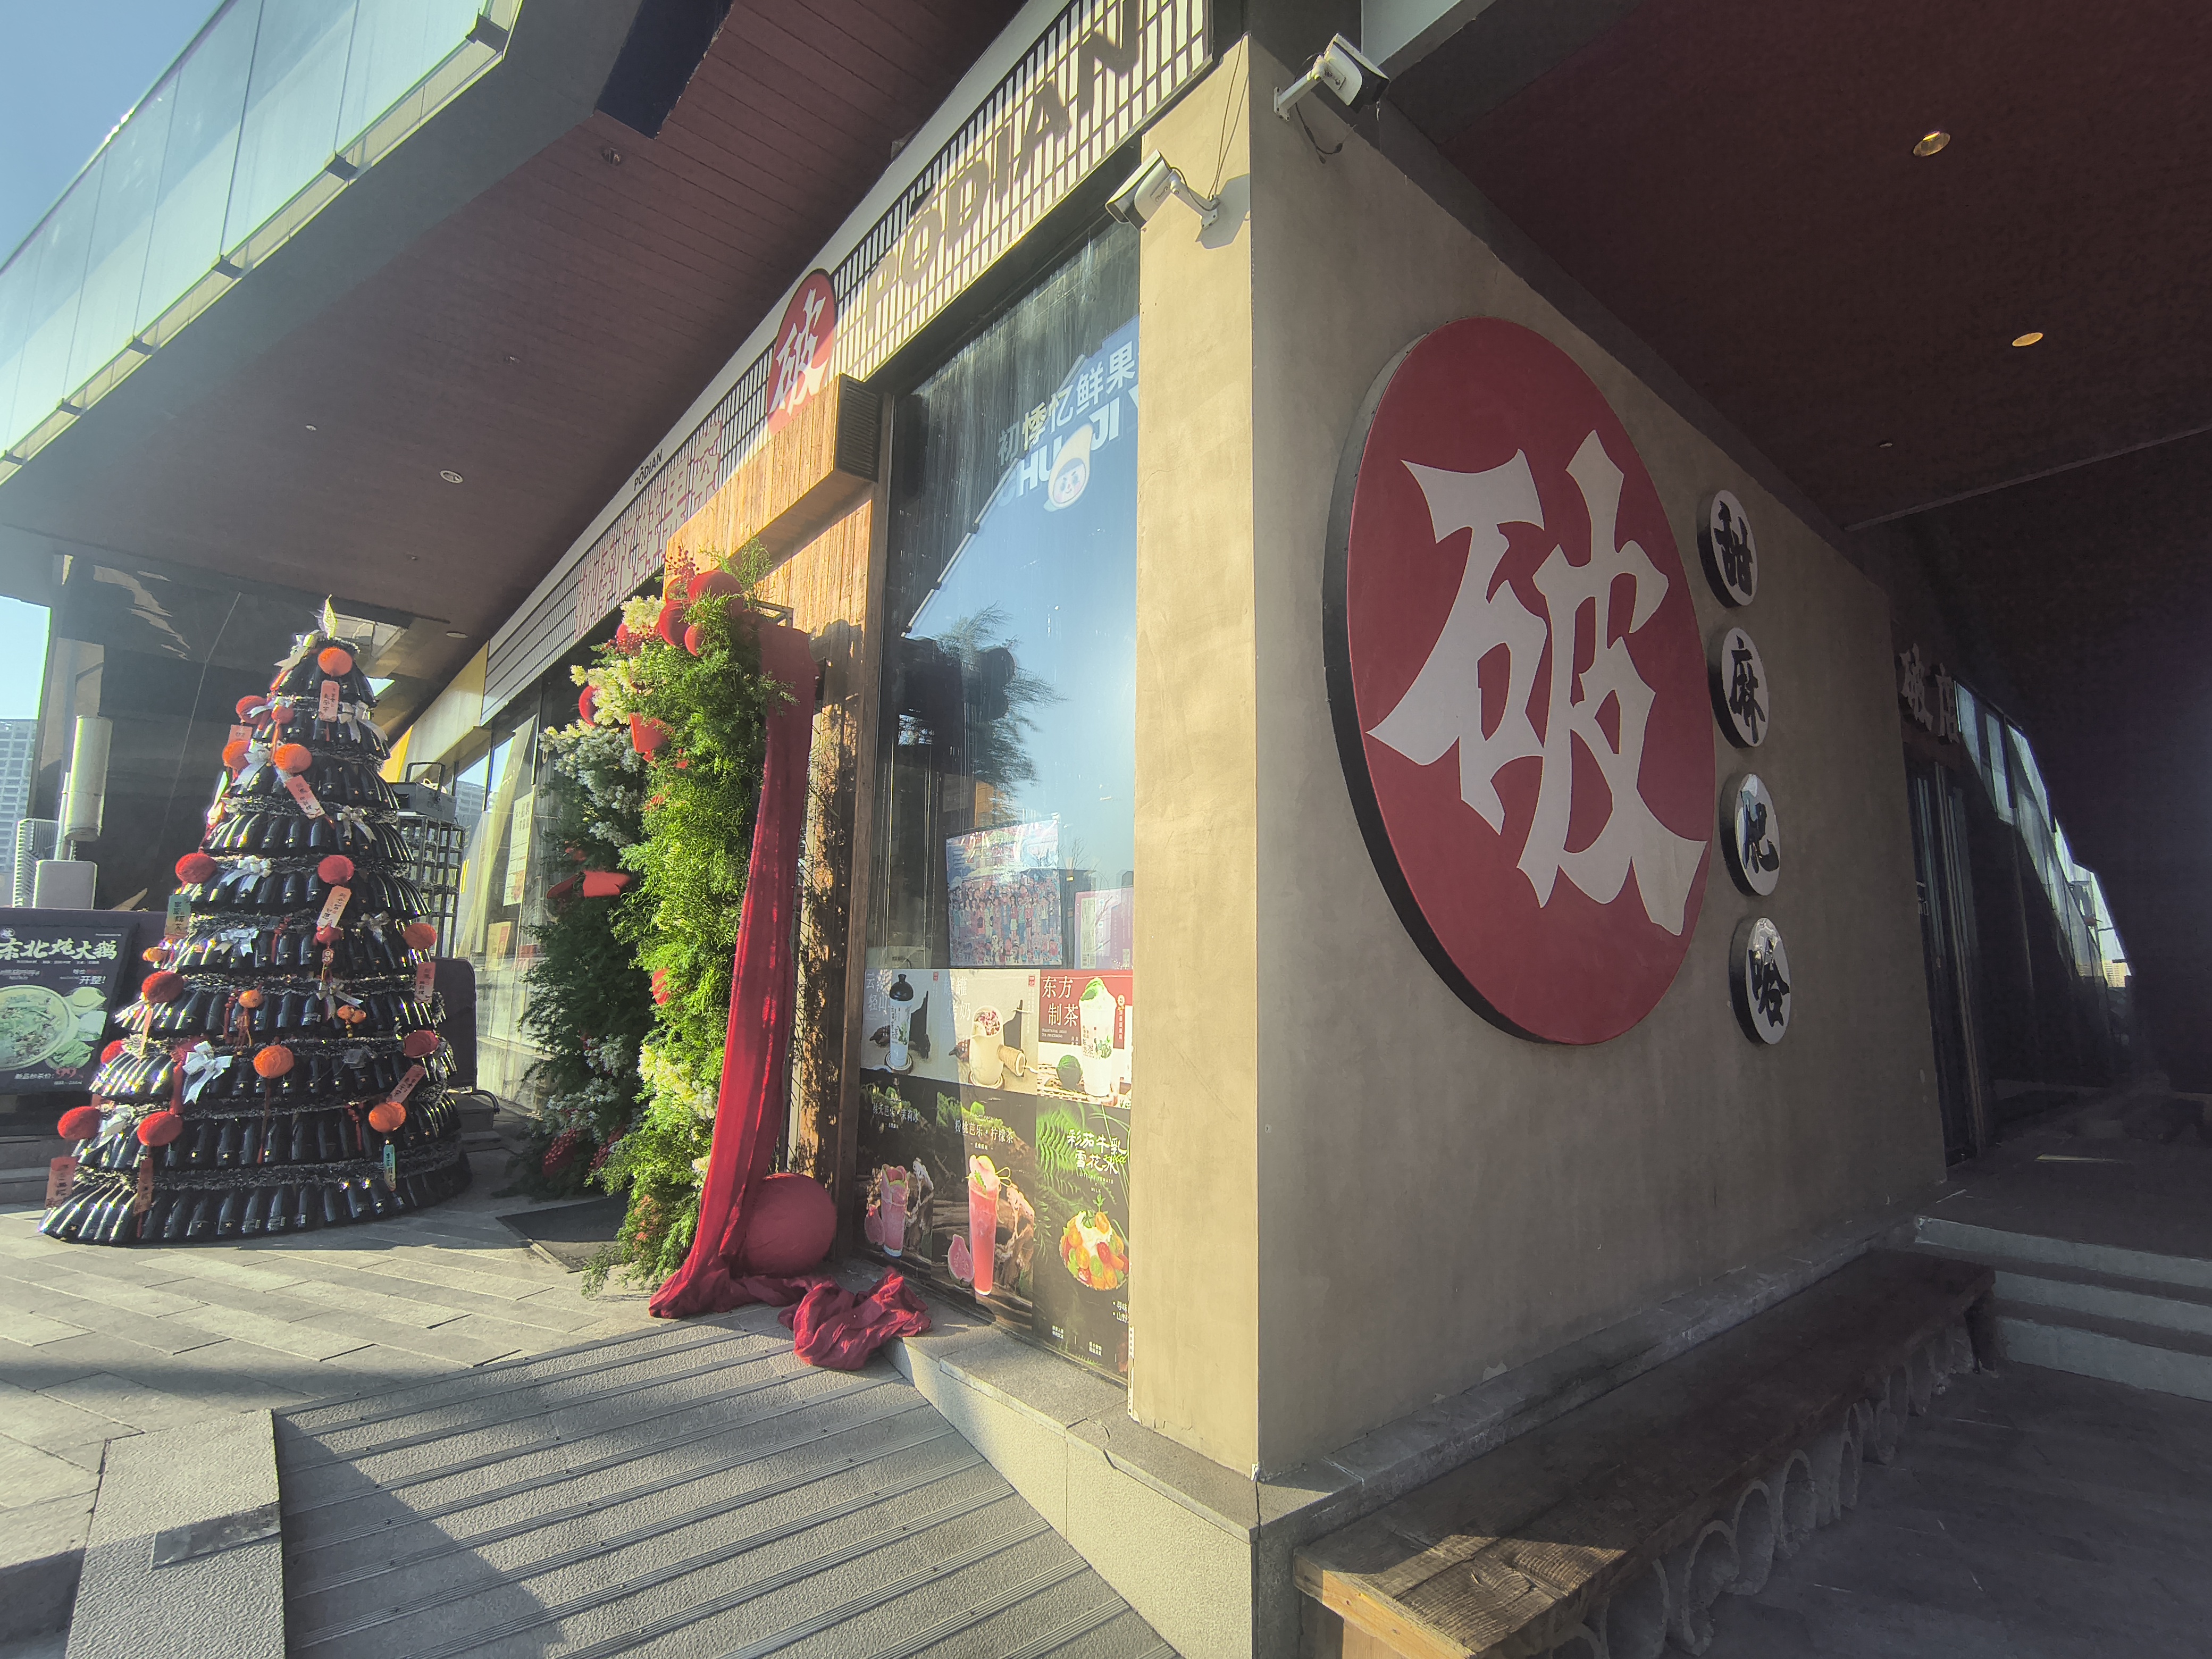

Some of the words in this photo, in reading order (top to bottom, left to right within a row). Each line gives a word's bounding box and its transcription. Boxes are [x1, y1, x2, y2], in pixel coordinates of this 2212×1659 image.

[769, 288, 829, 417] 破
[1366, 429, 1707, 936] 破
[1042, 976, 1074, 999] 东方
[1048, 1002, 1079, 1027] 制茶
[1067, 1129, 1127, 1155] 彩茄牛乳
[1075, 1150, 1118, 1174] 雪花冰
